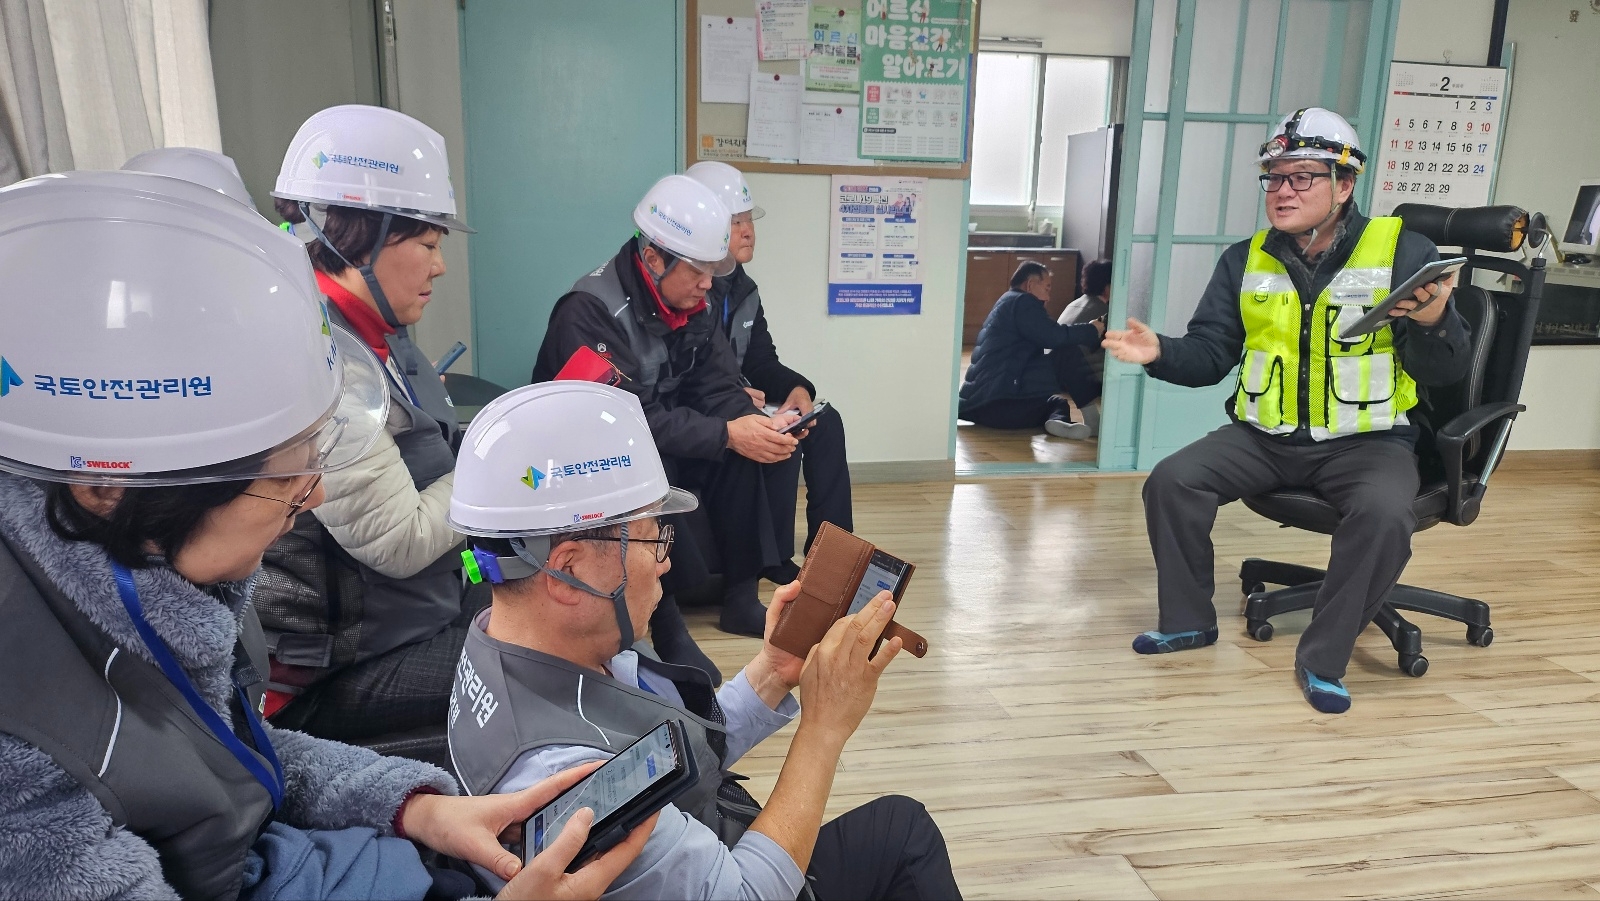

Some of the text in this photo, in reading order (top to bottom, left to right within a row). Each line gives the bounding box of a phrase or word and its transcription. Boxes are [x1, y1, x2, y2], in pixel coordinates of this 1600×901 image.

[866, 0, 929, 23] 어르신
[865, 24, 951, 52] 마음건강
[882, 54, 966, 80] 알아보기
[1440, 76, 1451, 91] 2
[1455, 100, 1491, 111] 1 2 3
[1395, 118, 1490, 132] 4 5 6 7 8 9 10
[1391, 139, 1487, 153] 11 12 13 14 15 16 17
[329, 153, 399, 175] 국토안전관리원
[1388, 161, 1484, 173] 18 19 20 21 22 23 24
[1383, 181, 1450, 193] 25 26 27 28 29
[34, 374, 212, 400] 국토안전관리원
[86, 460, 131, 469] SWELOCK
[550, 454, 632, 479] 국토안전관리원
